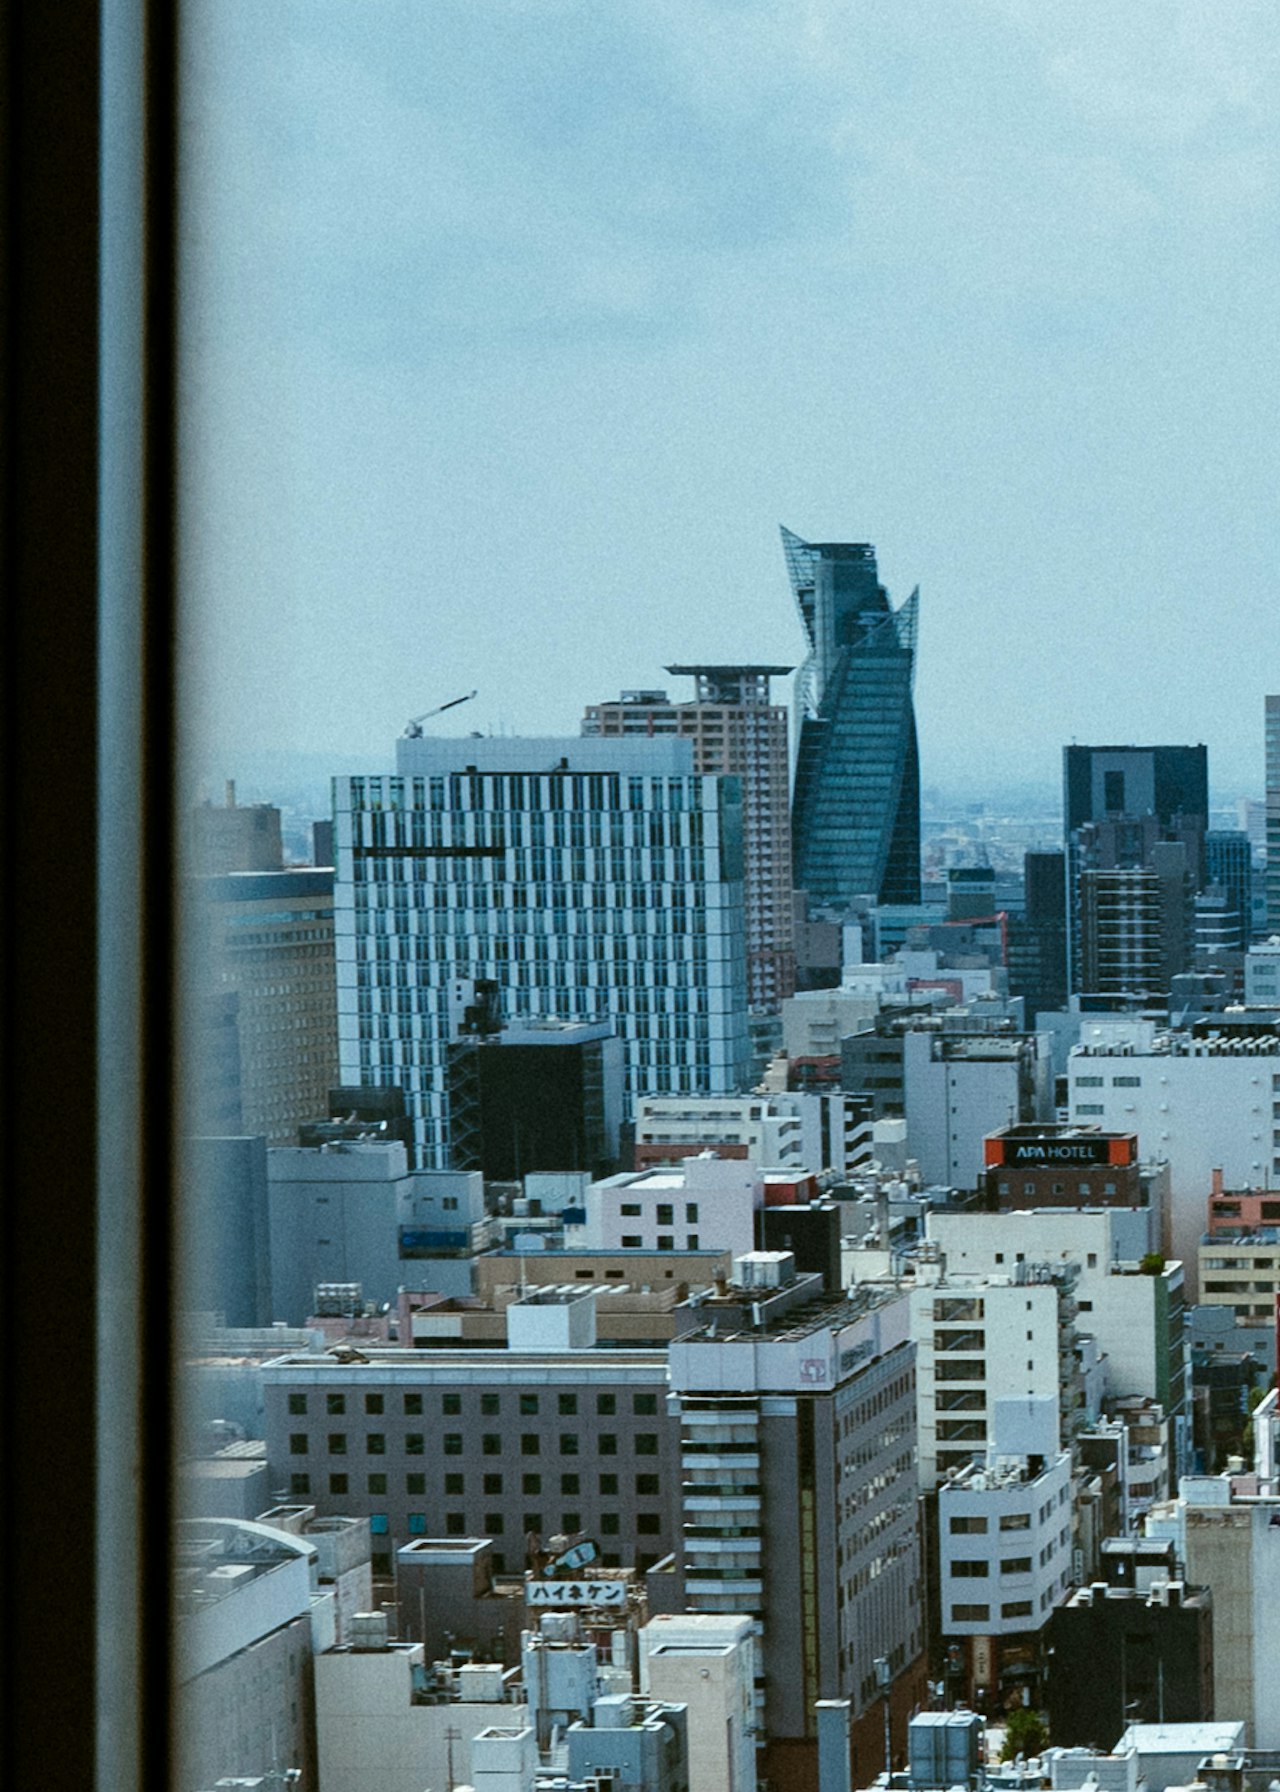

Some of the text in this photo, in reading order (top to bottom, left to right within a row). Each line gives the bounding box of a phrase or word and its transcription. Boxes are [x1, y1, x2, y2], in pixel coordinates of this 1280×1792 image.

[1016, 1146, 1096, 1158] APA HOTEL
[532, 1585, 621, 1600] ハイネケン
